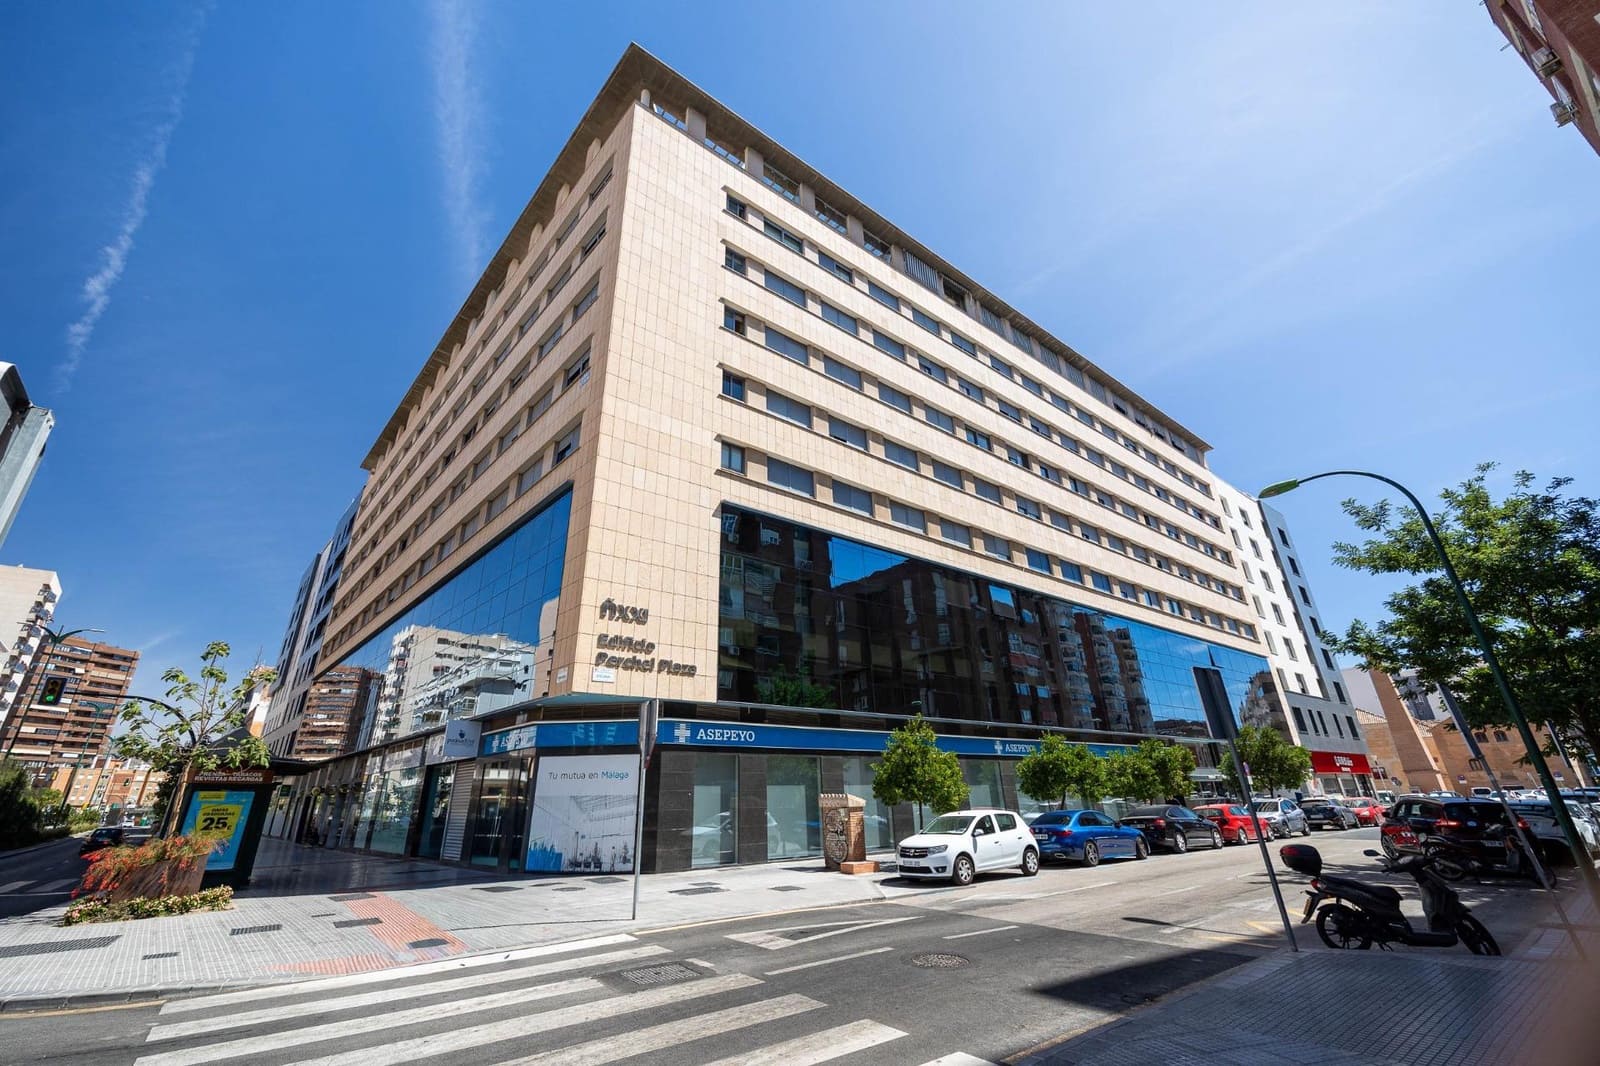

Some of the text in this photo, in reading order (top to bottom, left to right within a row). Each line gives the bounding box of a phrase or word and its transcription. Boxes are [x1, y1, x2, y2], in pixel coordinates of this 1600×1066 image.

[596, 633, 656, 655] Edificio
[594, 652, 698, 678] Perchel Plaza
[696, 728, 756, 742] ASEPEYO
[547, 772, 558, 780] Tu
[560, 772, 586, 780] mutua
[588, 772, 599, 780] en
